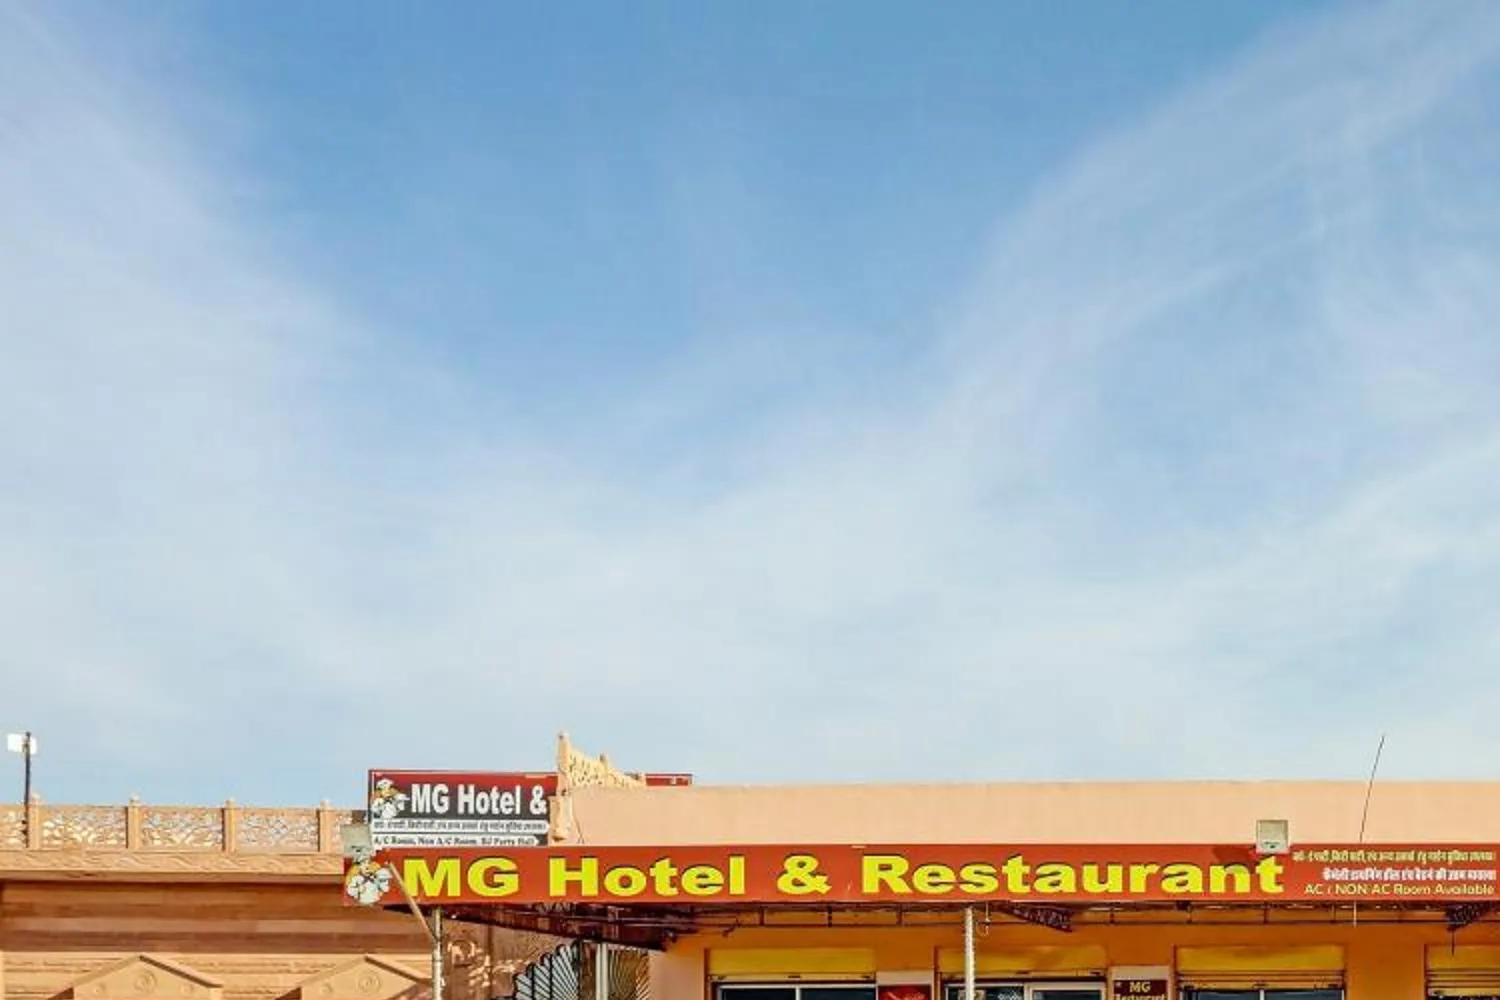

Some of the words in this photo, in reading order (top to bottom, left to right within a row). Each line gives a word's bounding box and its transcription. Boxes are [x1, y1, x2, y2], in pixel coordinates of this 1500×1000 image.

[411, 784, 449, 814] MG
[457, 784, 522, 815] Hotel
[530, 785, 547, 815] &
[402, 856, 520, 897] MG
[548, 856, 745, 897] Hotel
[777, 854, 832, 895] &
[861, 853, 1285, 894] Restaurant
[1304, 884, 1324, 895] AC
[1335, 884, 1367, 895] NON
[1371, 884, 1390, 895] AC
[1394, 884, 1430, 895] Room
[1434, 884, 1495, 895] Available
[1129, 981, 1151, 993] MG
